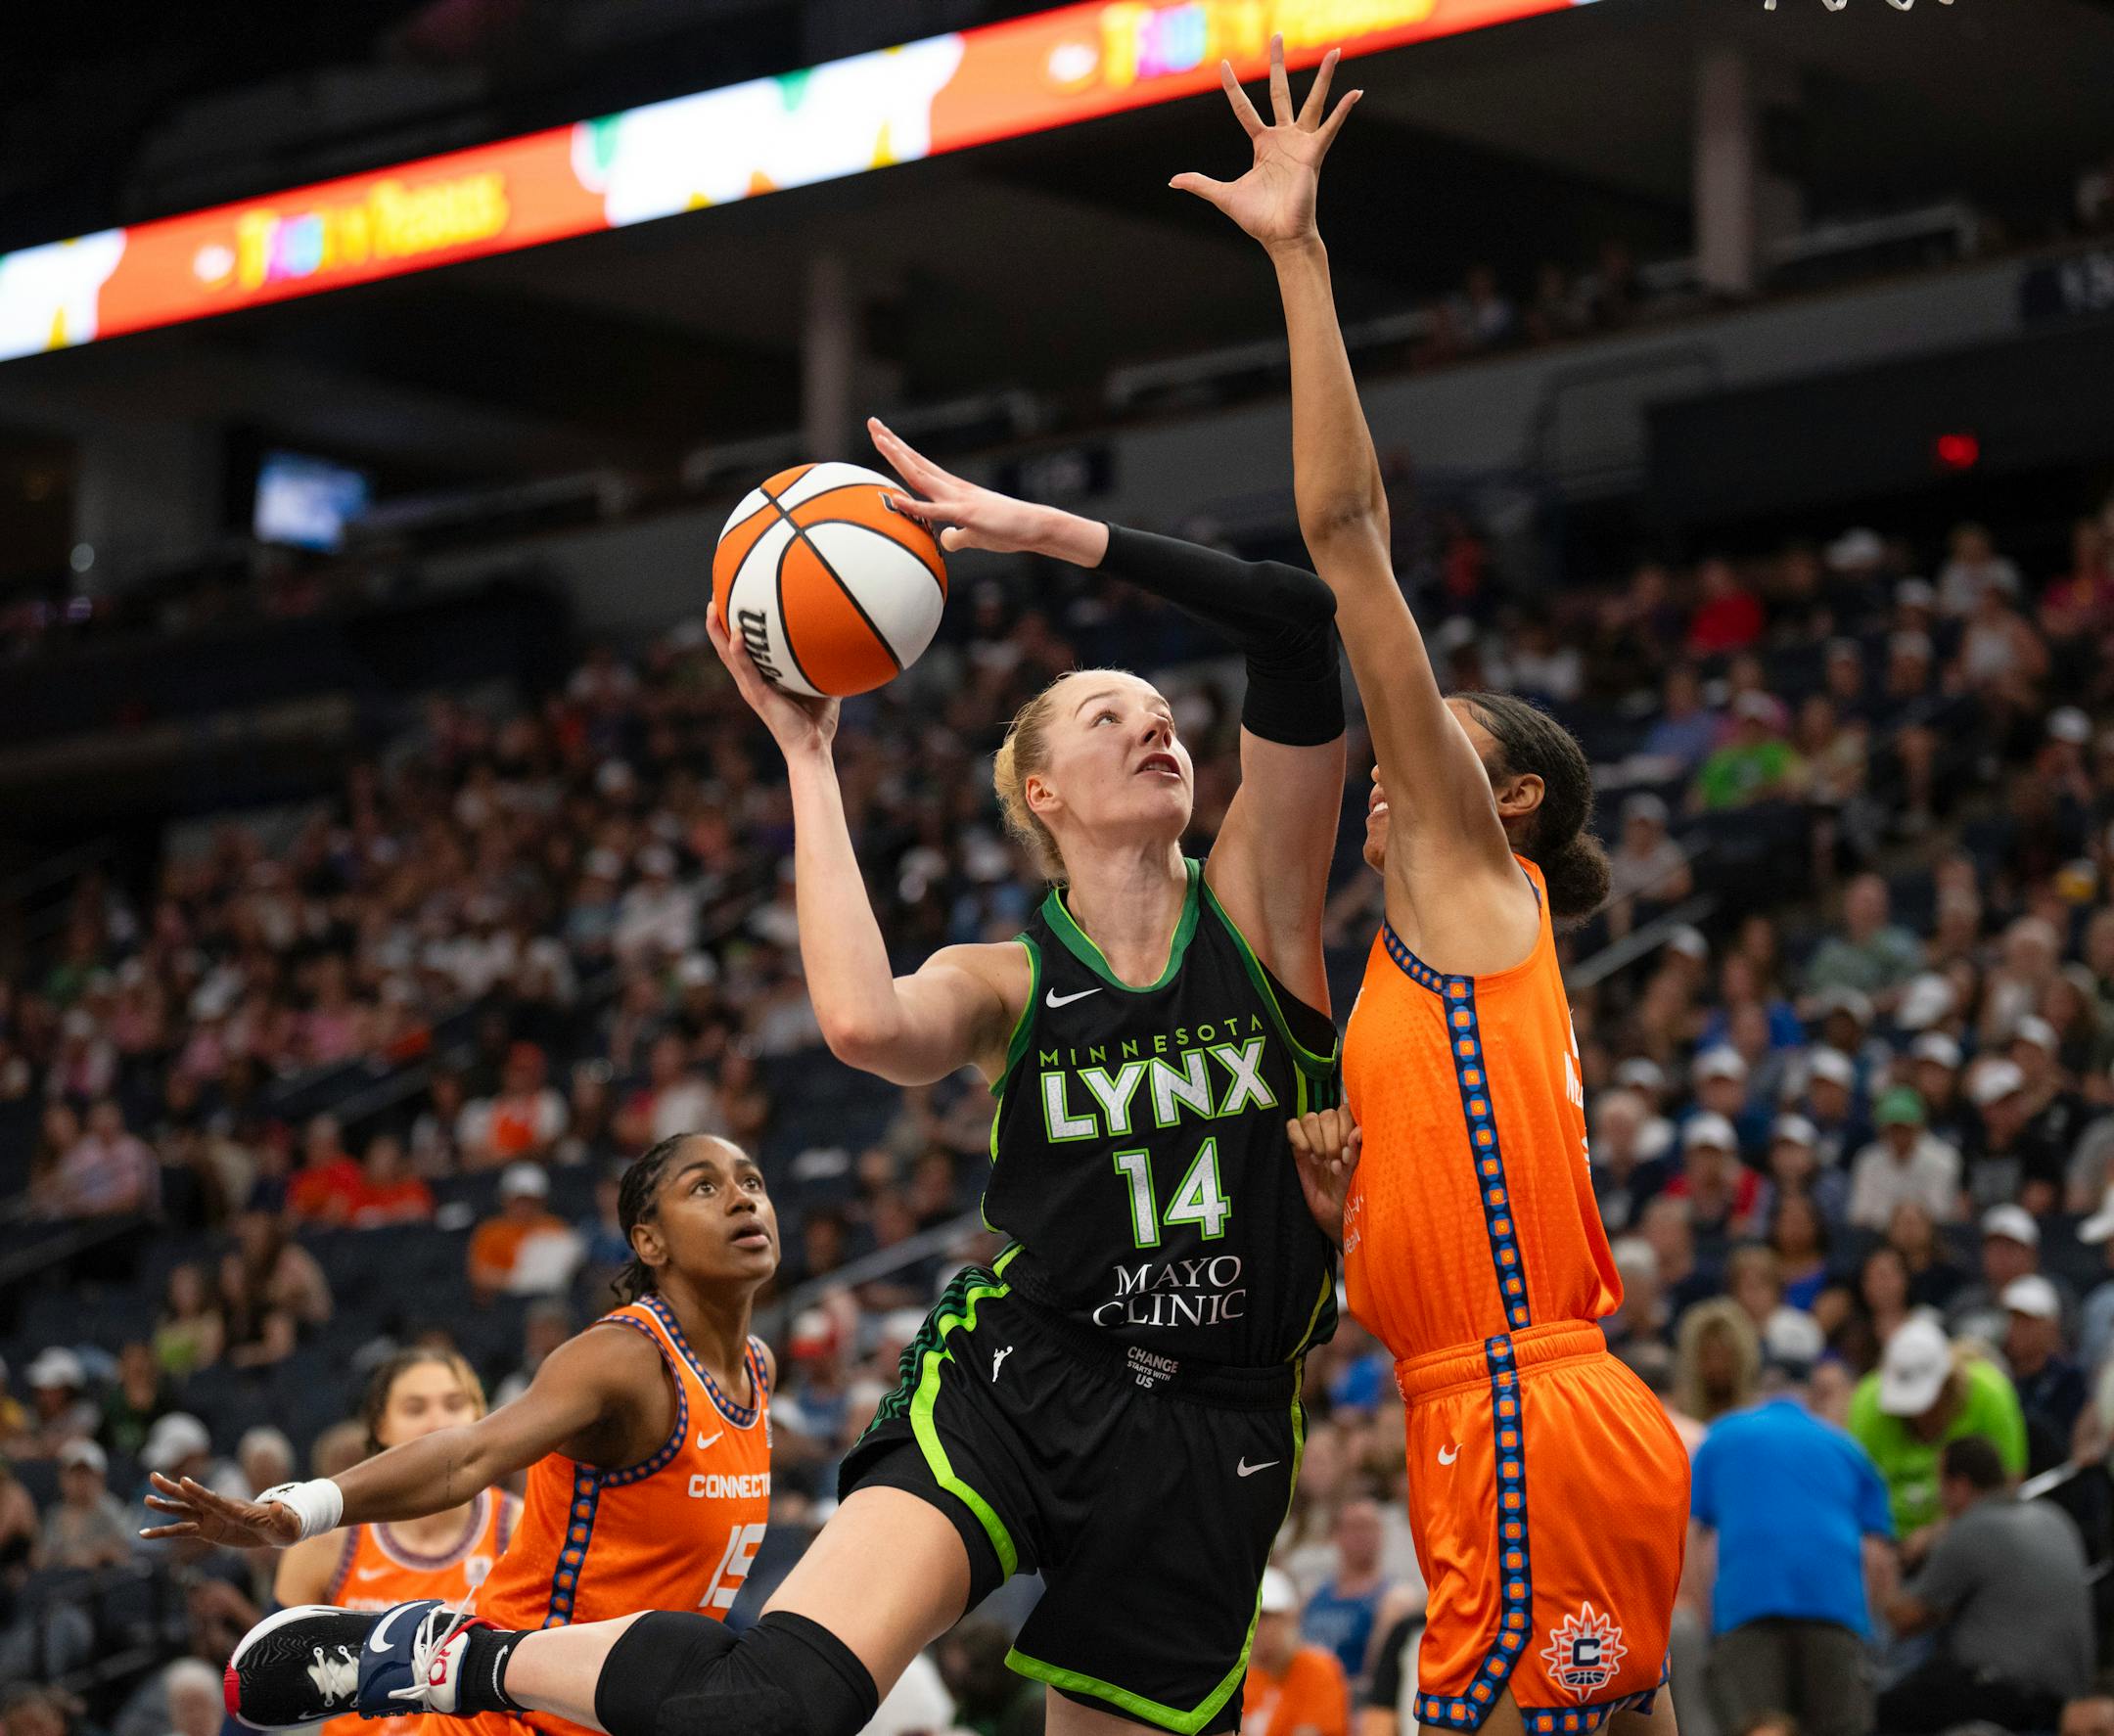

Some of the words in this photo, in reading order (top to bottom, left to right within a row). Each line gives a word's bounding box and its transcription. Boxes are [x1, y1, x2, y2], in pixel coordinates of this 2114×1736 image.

[1039, 1014, 1264, 1068] MINNESOTA
[1040, 1035, 1279, 1143] LYNX
[1113, 1136, 1232, 1249] 14
[1113, 1256, 1242, 1297] MAYO
[1092, 1289, 1247, 1327] CLINIC
[1126, 1346, 1180, 1374] CHANGE
[1126, 1360, 1153, 1376] STARTS
[1152, 1370, 1172, 1382] WITH
[1135, 1373, 1155, 1389] US
[698, 1523, 767, 1609] 15
